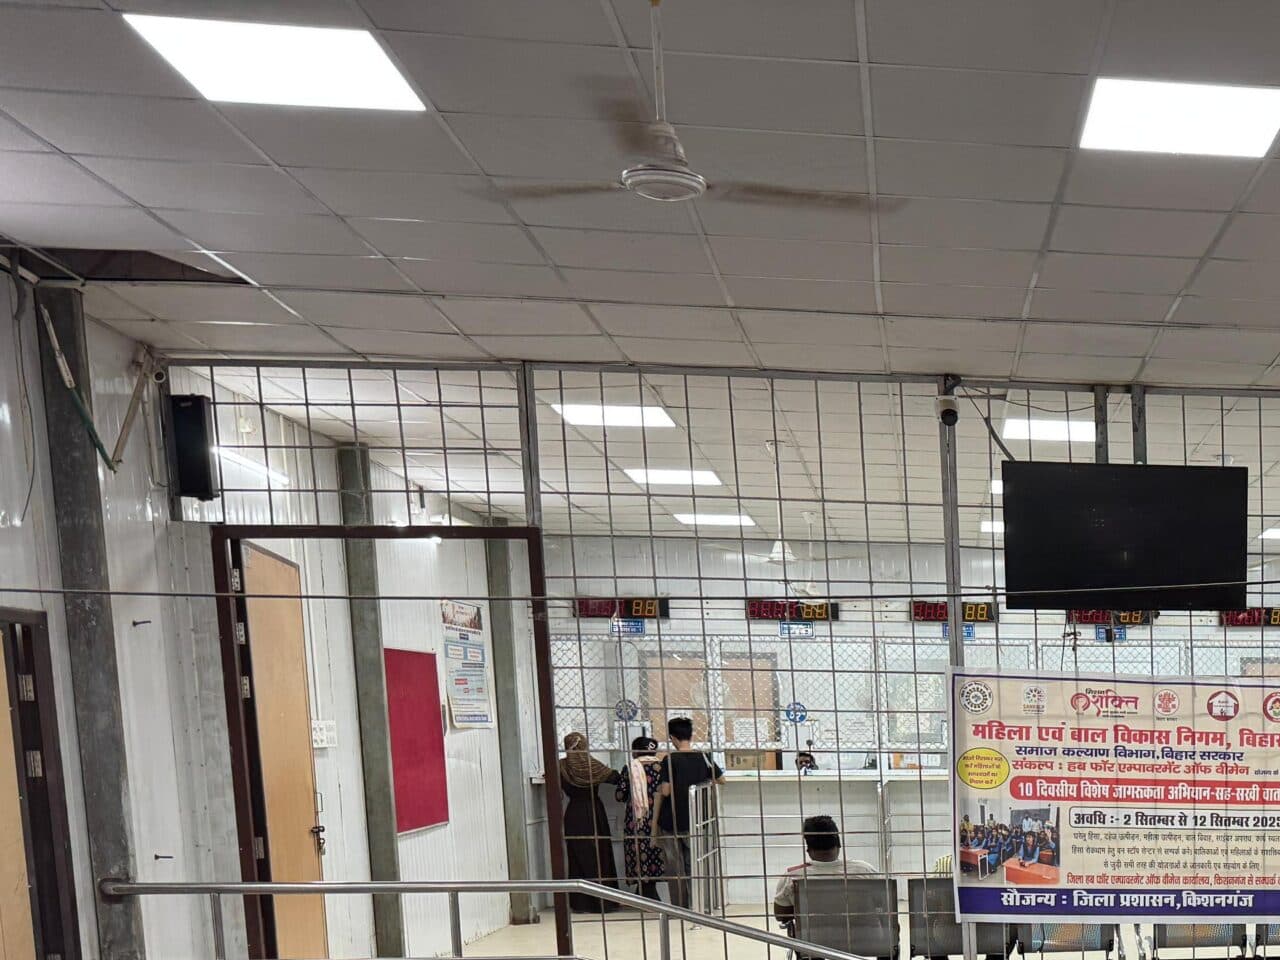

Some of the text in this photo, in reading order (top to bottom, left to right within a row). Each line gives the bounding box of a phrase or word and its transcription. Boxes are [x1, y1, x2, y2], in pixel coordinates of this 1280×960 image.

[972, 720, 1032, 741] महिला
[1037, 721, 1065, 742] एवं
[1070, 729, 1109, 744] बाल
[1113, 724, 1171, 745] विकास
[1176, 726, 1232, 749] निगम,
[1015, 746, 1057, 757] समाज
[1062, 747, 1110, 758] कल्याण
[1199, 750, 1244, 762] सरकार
[1012, 757, 1054, 772] संकल्प
[1067, 762, 1087, 772] हब
[1090, 760, 1115, 773] फॉर
[1118, 761, 1181, 774] एम्पावरमेंट
[1184, 762, 1212, 774] ऑफ
[1215, 763, 1250, 776] वीमेन
[1018, 783, 1033, 797] 10
[1036, 780, 1077, 798] दिवसीय
[1081, 779, 1110, 798] विशेष
[1074, 810, 1106, 825] अवधि
[1124, 814, 1132, 825] 2
[1136, 811, 1176, 826] सितम्बर
[1178, 811, 1188, 826] से
[1192, 815, 1206, 827] 12
[1210, 813, 1249, 827] सितम्बर
[1067, 872, 1084, 884] जिला
[1086, 875, 1095, 884] हब
[1248, 873, 1254, 886] से
[1001, 889, 1057, 907] सौजन्य
[1061, 895, 1068, 905] :
[1073, 889, 1117, 907] जिला
